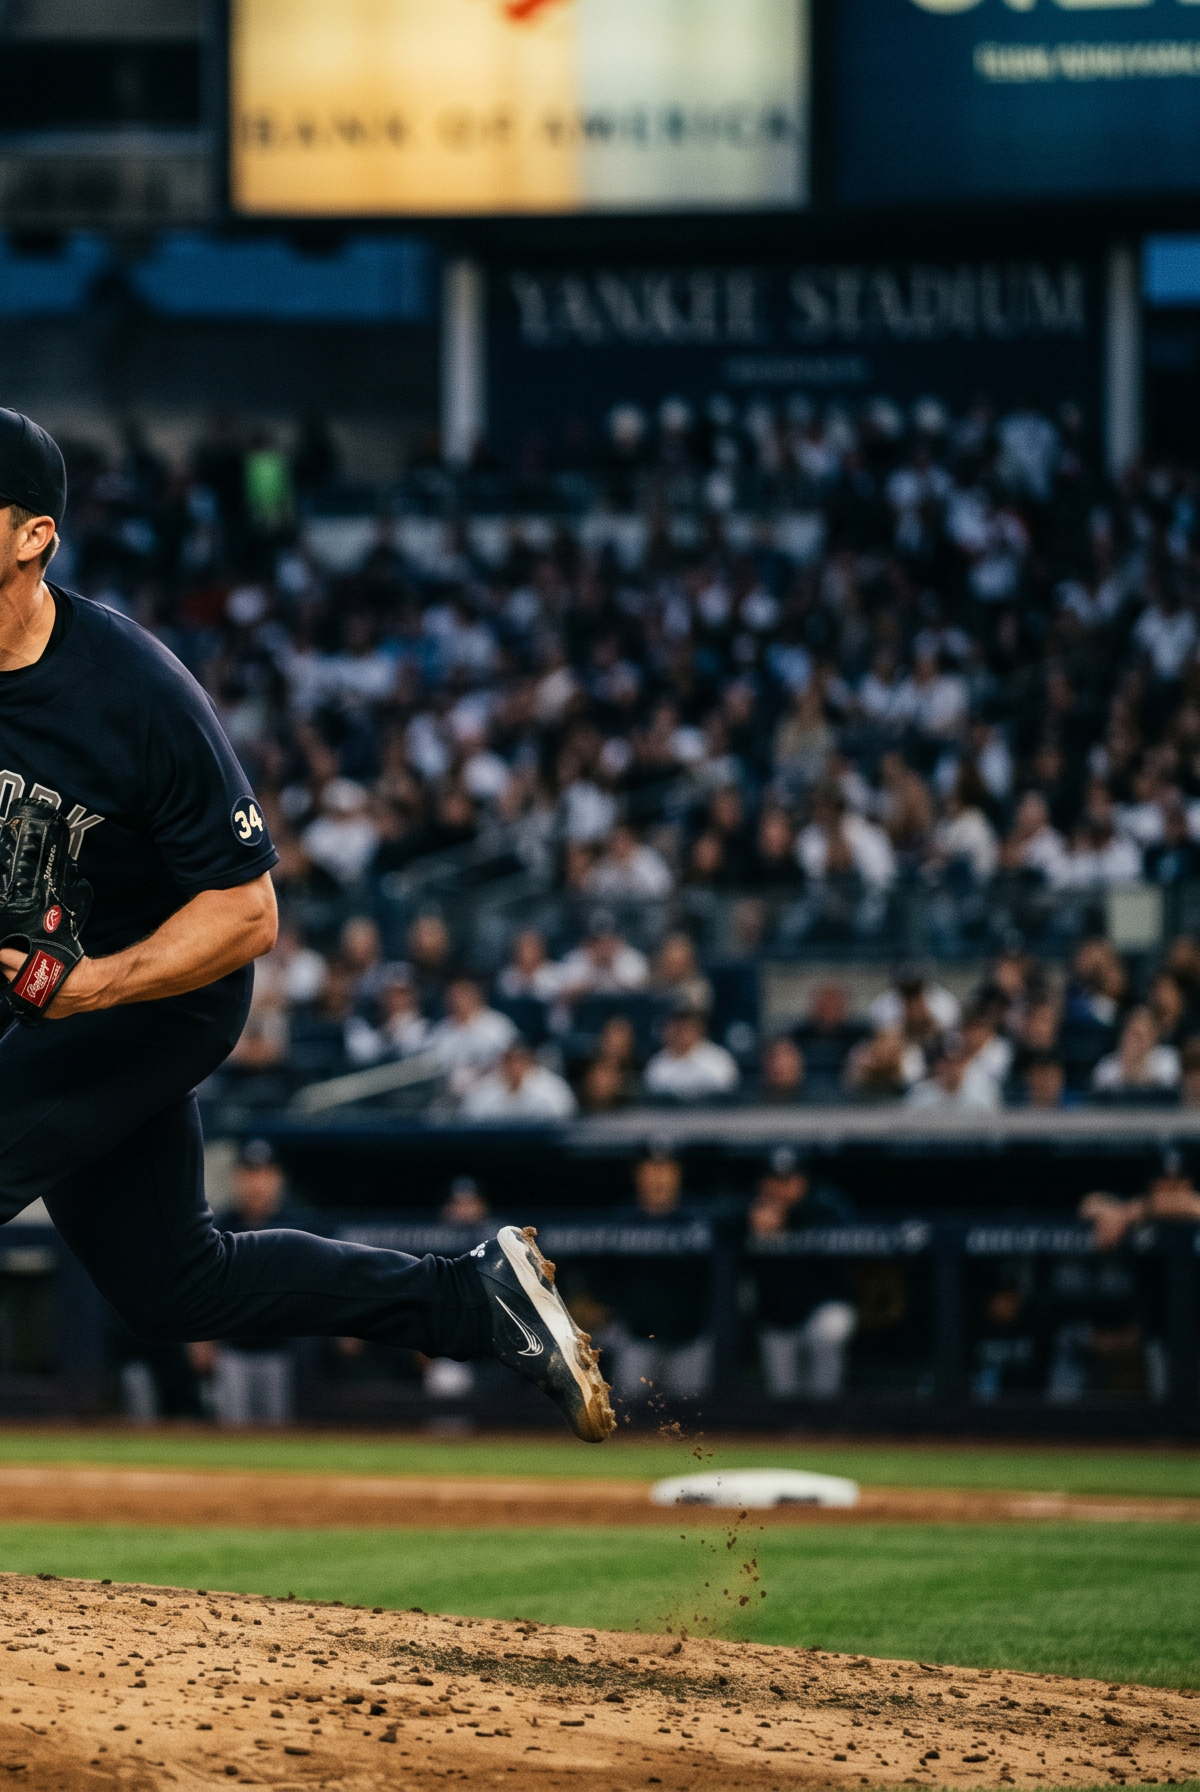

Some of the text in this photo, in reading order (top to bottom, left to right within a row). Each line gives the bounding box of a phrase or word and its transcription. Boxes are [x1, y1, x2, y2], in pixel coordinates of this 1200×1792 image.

[510, 263, 1087, 346] YANKEE STADIUM
[234, 804, 263, 839] 34
